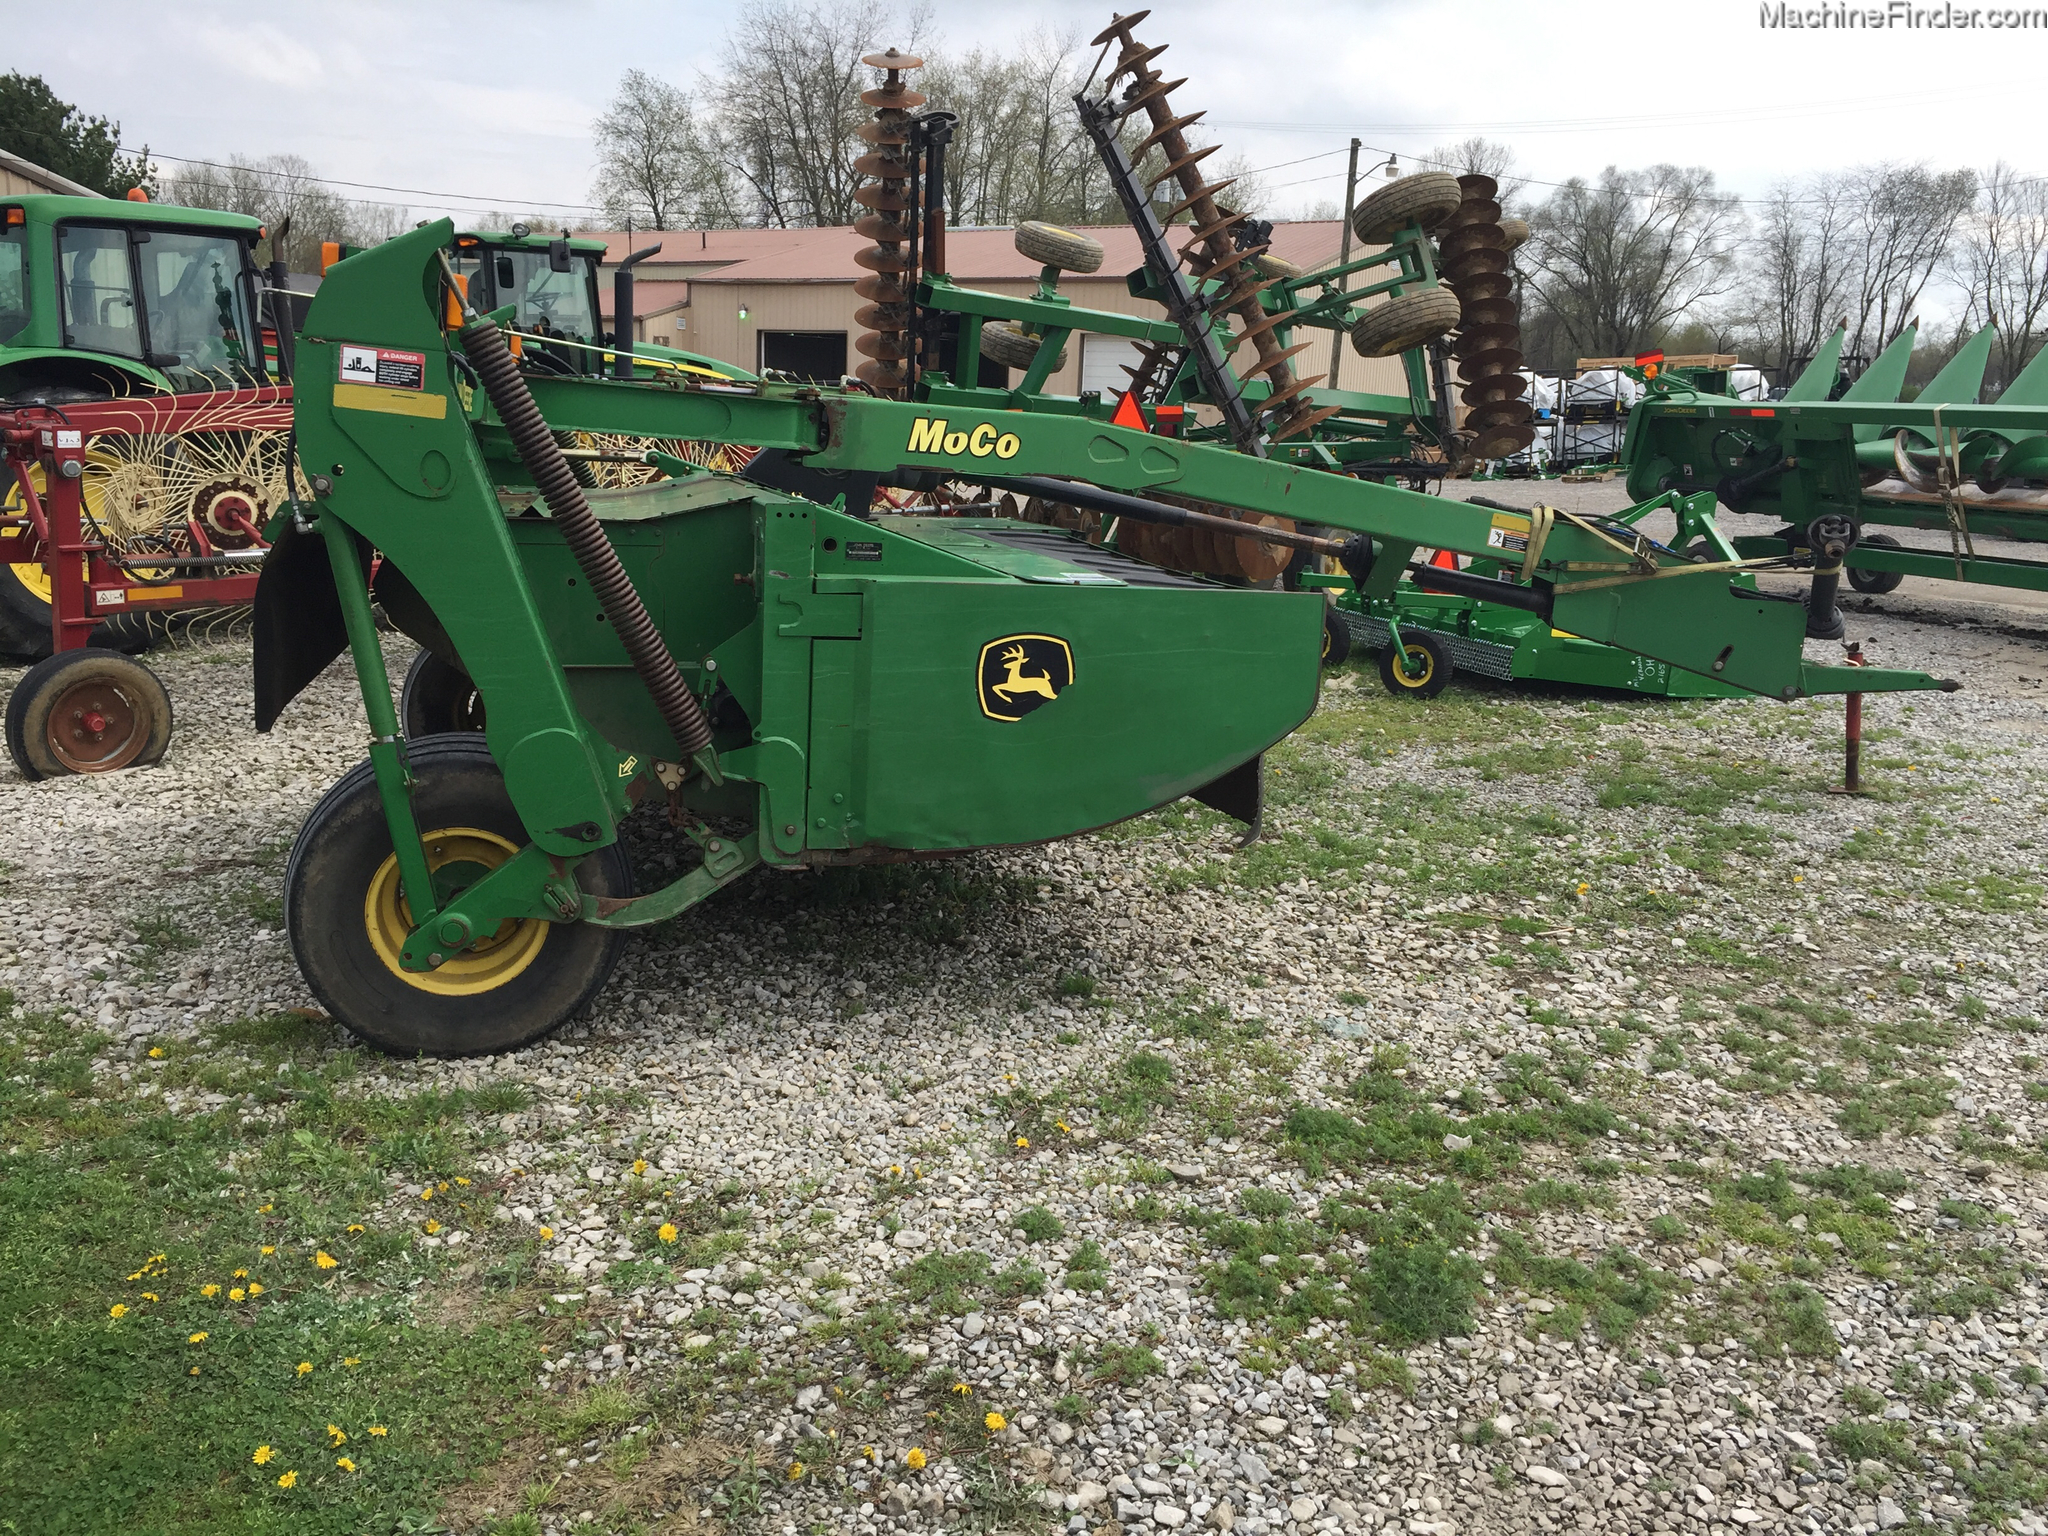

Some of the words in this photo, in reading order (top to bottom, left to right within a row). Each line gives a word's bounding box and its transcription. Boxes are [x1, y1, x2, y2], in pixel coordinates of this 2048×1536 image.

[390, 352, 418, 362] DANGER
[1663, 406, 1678, 414] JOHN
[1678, 406, 1697, 414] DEERE
[906, 417, 1021, 460] MoCo
[1644, 659, 1655, 676] OH
